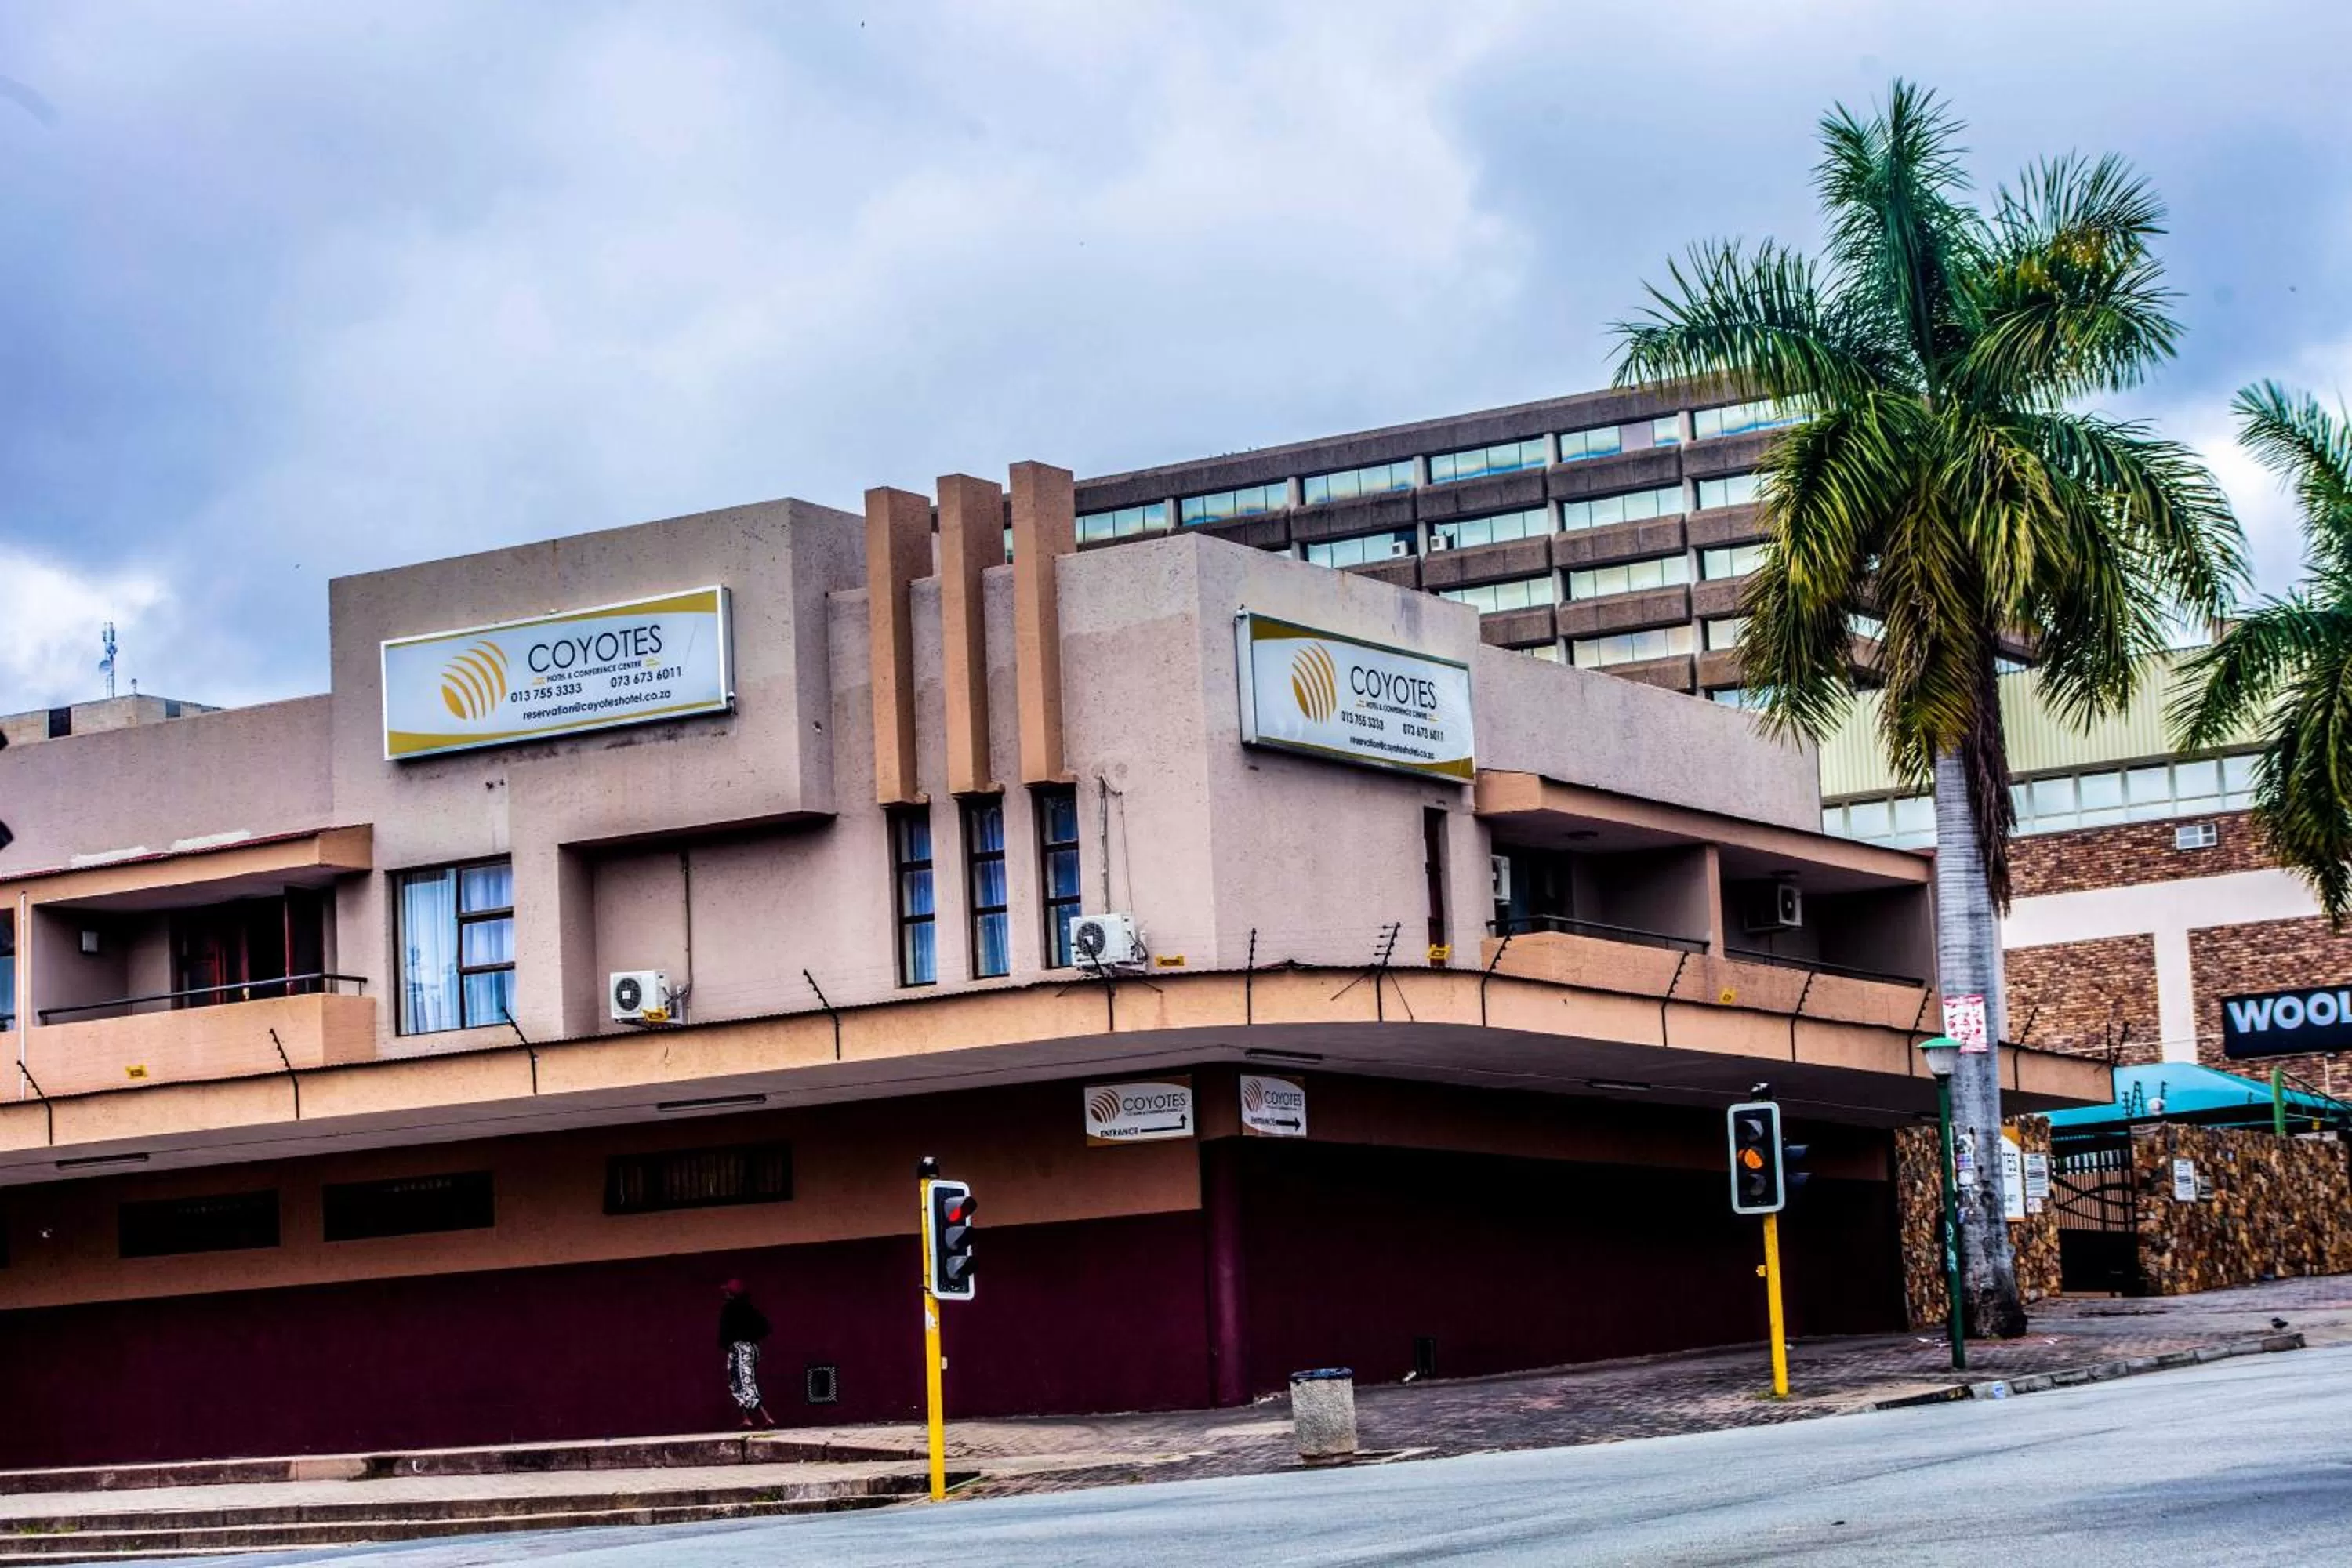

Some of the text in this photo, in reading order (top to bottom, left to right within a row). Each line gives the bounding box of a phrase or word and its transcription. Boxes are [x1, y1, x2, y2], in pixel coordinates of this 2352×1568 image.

[528, 625, 662, 673] COYOTES
[546, 673, 566, 682] HOTEL
[573, 664, 616, 678] CONFERENCE
[610, 666, 682, 688] 073 673 6011
[510, 682, 583, 702] 013 755 3333
[1350, 666, 1438, 710] COYOTES
[522, 689, 672, 720] reservation@coyoteshotel.co.za
[2227, 990, 2352, 1034] WOOL
[1122, 1093, 1187, 1112] COYOTES
[1264, 1091, 1303, 1106] COYOTES
[1100, 1127, 1139, 1138] ENTRANCE
